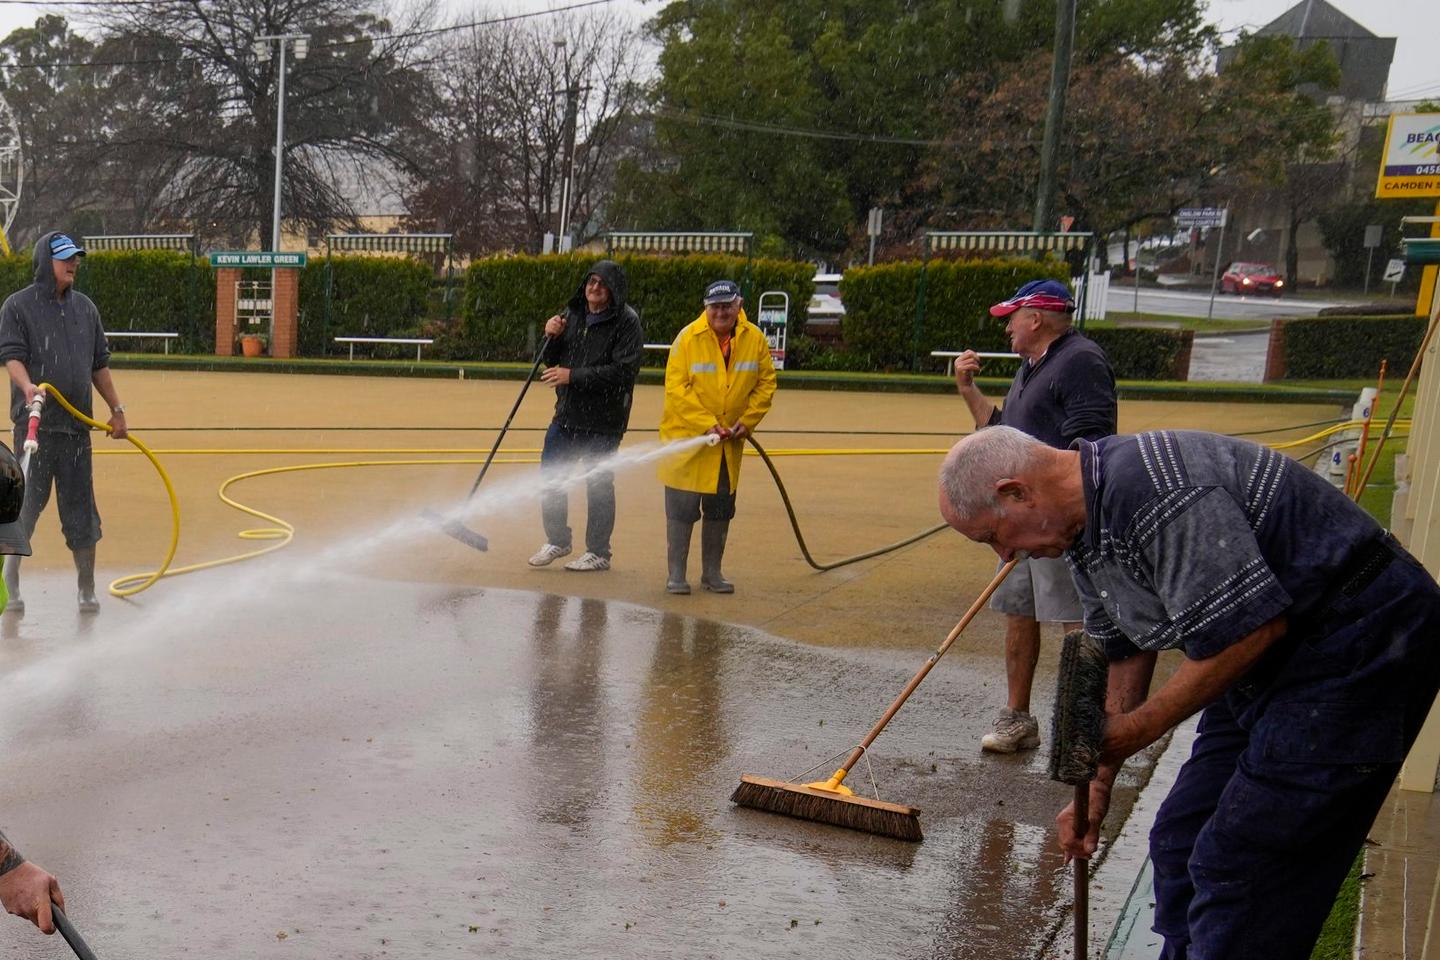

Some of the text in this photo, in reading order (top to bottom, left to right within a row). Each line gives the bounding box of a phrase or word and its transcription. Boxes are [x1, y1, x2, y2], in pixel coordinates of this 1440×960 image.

[1384, 182, 1432, 190] CAMDEN
[217, 255, 299, 264] KEVIN LAWLER GREEN
[1363, 407, 1370, 417] 6
[1333, 451, 1341, 465] 4
